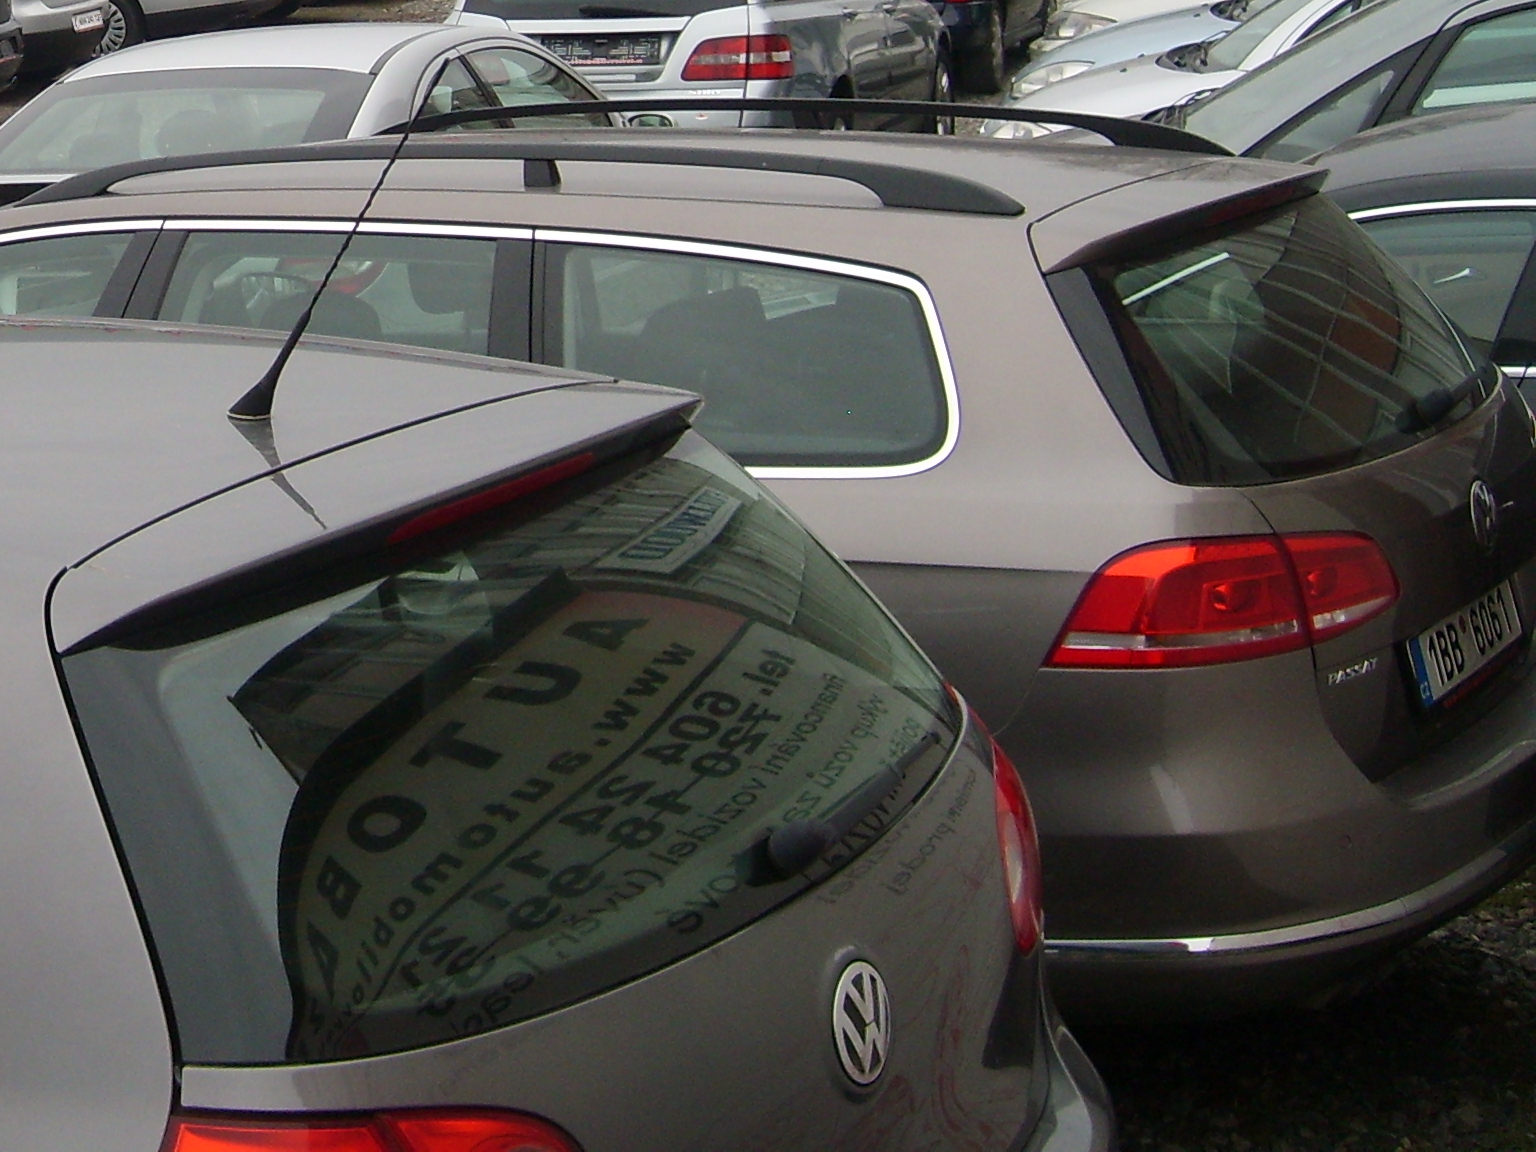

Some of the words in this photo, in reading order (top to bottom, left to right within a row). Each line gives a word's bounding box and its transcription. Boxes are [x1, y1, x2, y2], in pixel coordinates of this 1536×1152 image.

[1427, 623, 1465, 687] 1BB
[1467, 586, 1513, 656] 6061
[1327, 657, 1378, 686] PASSAT
